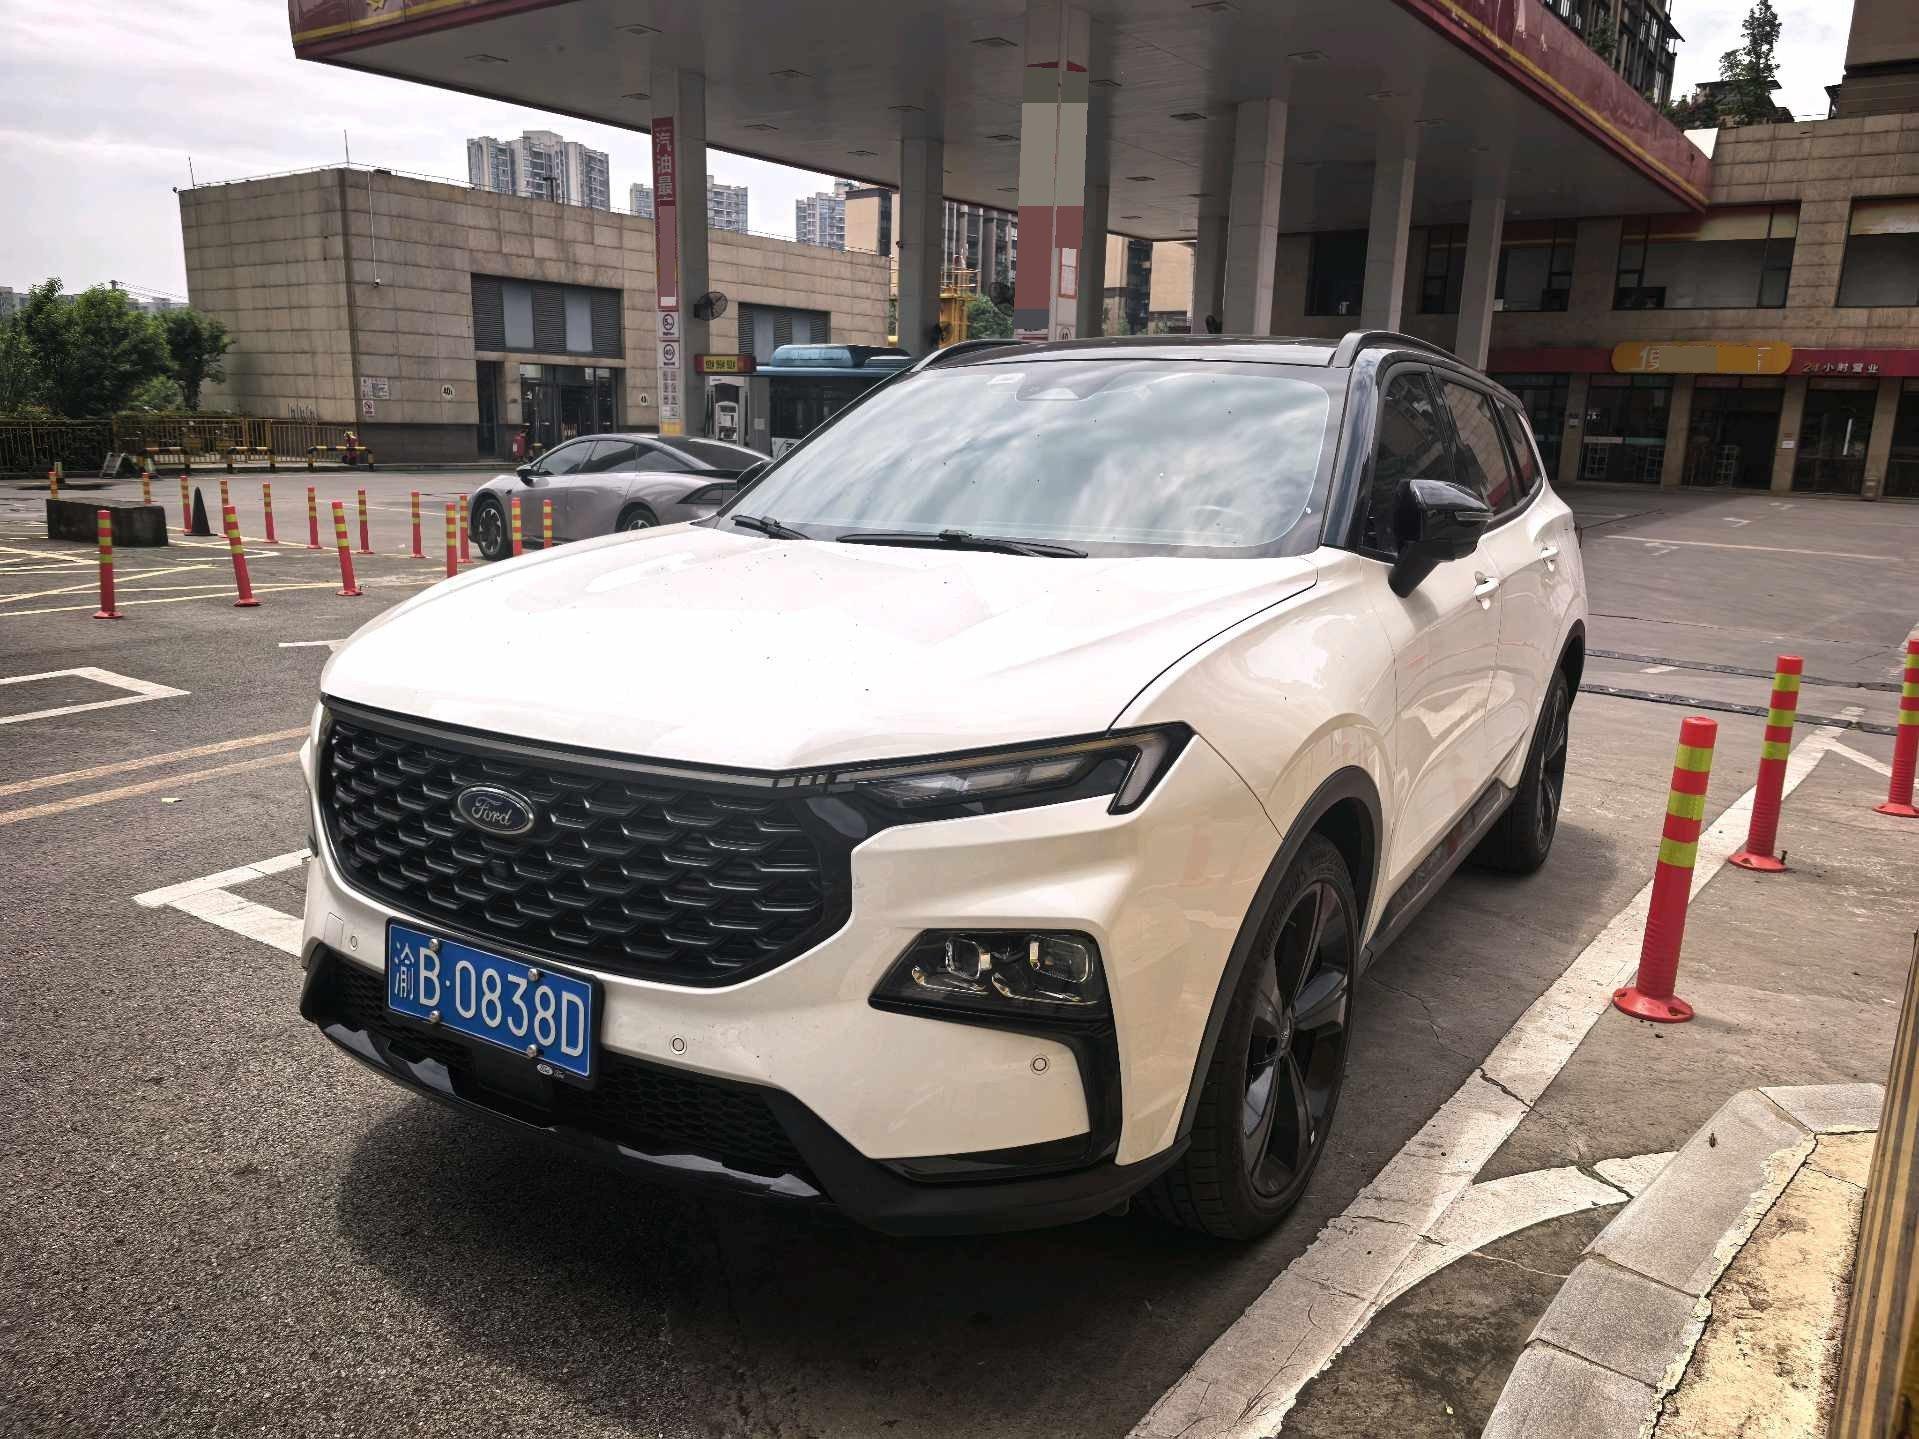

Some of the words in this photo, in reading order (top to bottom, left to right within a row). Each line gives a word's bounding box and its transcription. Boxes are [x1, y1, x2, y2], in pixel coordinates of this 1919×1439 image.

[655, 131, 673, 200] 汽油最
[1801, 362, 1880, 373] 24小时营业
[471, 796, 513, 826] Ford
